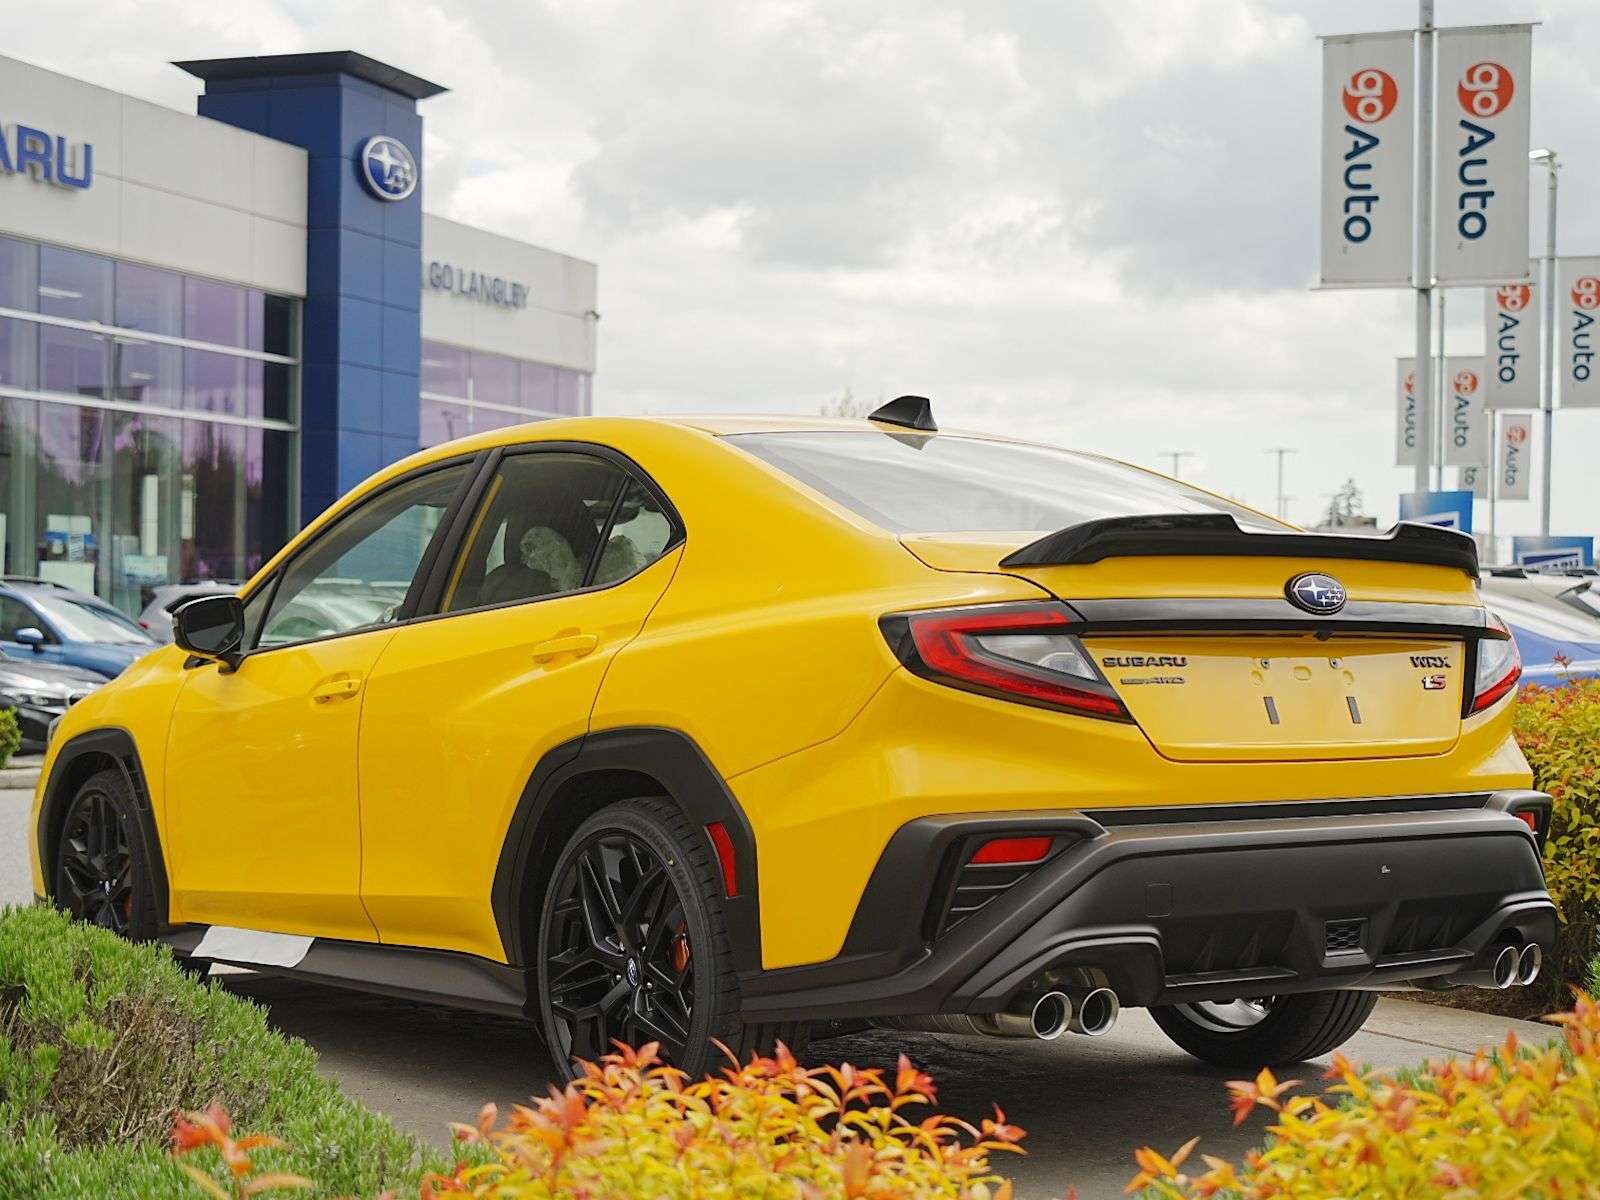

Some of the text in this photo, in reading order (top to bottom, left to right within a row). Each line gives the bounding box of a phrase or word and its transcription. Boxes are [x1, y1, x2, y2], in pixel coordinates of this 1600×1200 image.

[1343, 69, 1386, 244] go Auto
[1458, 63, 1503, 240] go Auto
[429, 261, 530, 311] GO LANGLEY
[1498, 312, 1520, 383] Auto
[1572, 310, 1595, 381] Auto
[1454, 395, 1470, 447] Auto
[1102, 656, 1188, 668] SUBARU
[1409, 656, 1452, 668] WRX
